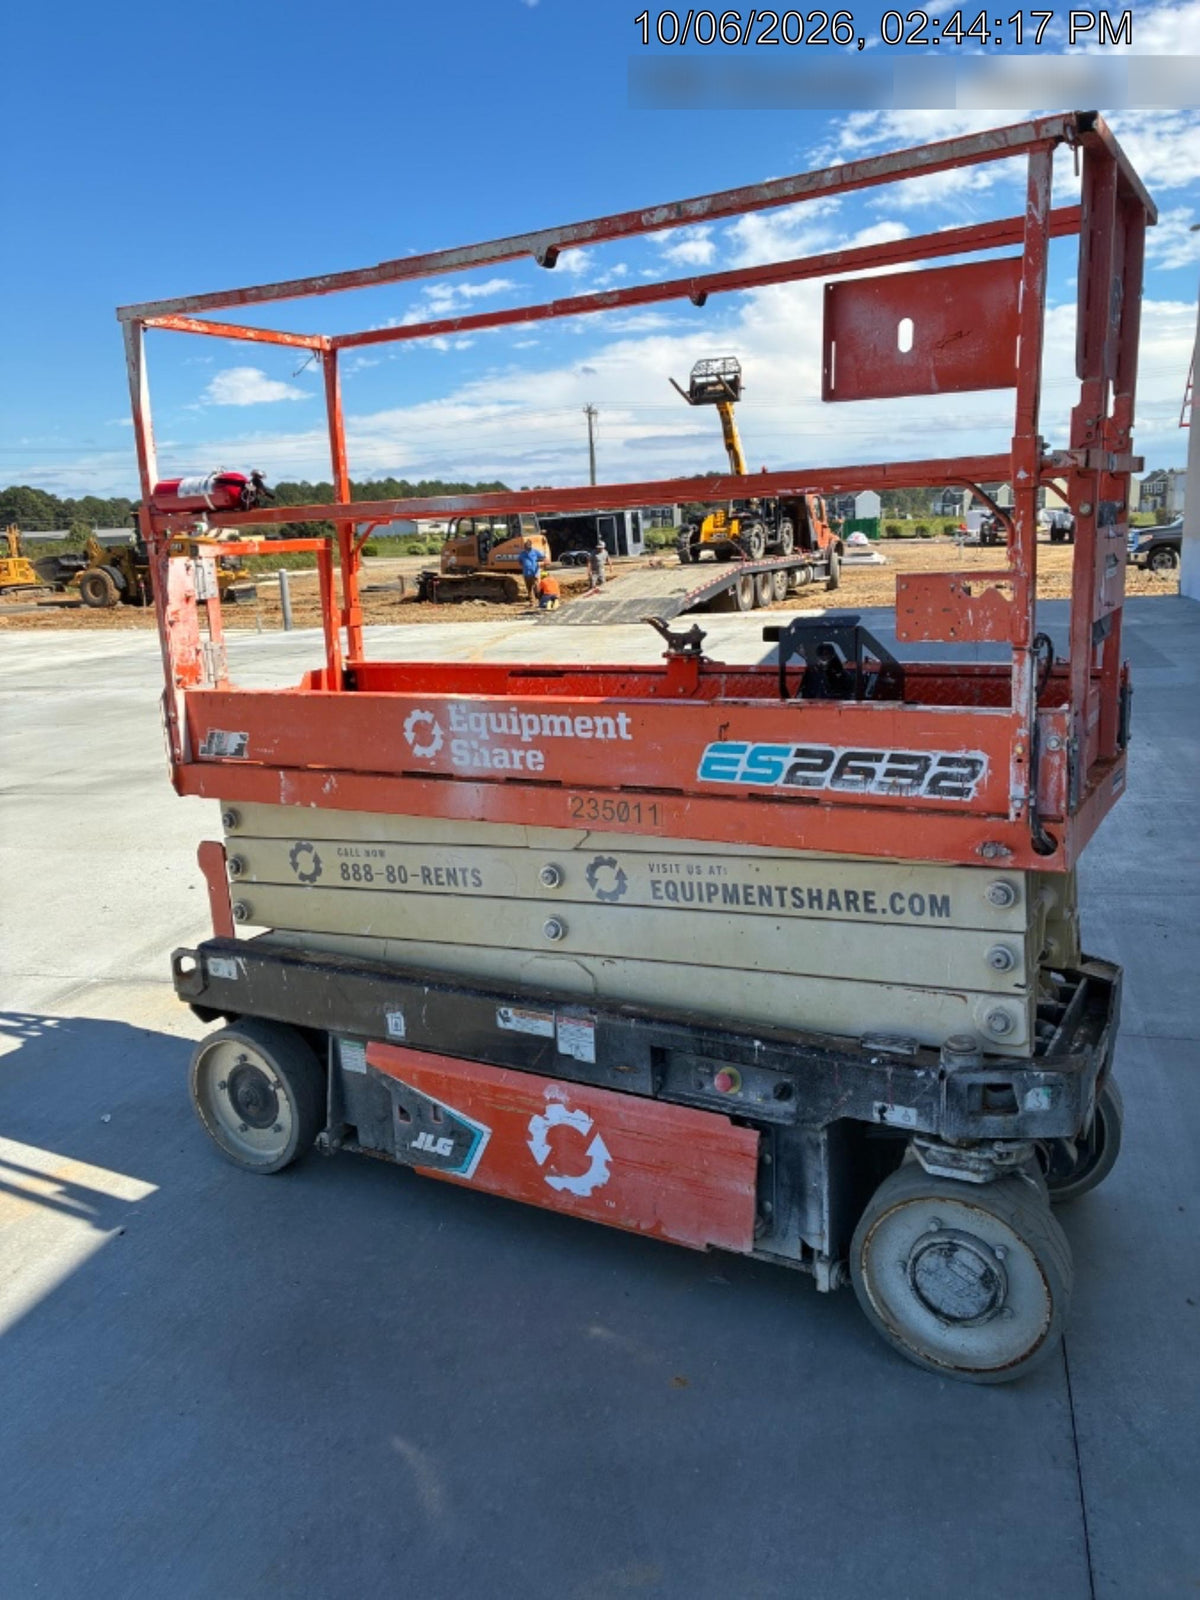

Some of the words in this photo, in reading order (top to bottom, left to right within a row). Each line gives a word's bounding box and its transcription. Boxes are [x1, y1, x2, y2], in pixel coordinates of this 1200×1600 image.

[448, 703, 633, 742] Equipment
[450, 738, 545, 771] Share
[697, 741, 989, 801] ES2632
[570, 796, 658, 826] 235011
[337, 847, 361, 858] CALL
[365, 849, 386, 858] NOW
[340, 862, 483, 888] 888-80-RENTS
[648, 863, 680, 874] VISIT
[686, 864, 702, 876] US
[650, 879, 951, 918] EQUIPMENTSHARE.COM
[410, 1132, 454, 1157] JLG
